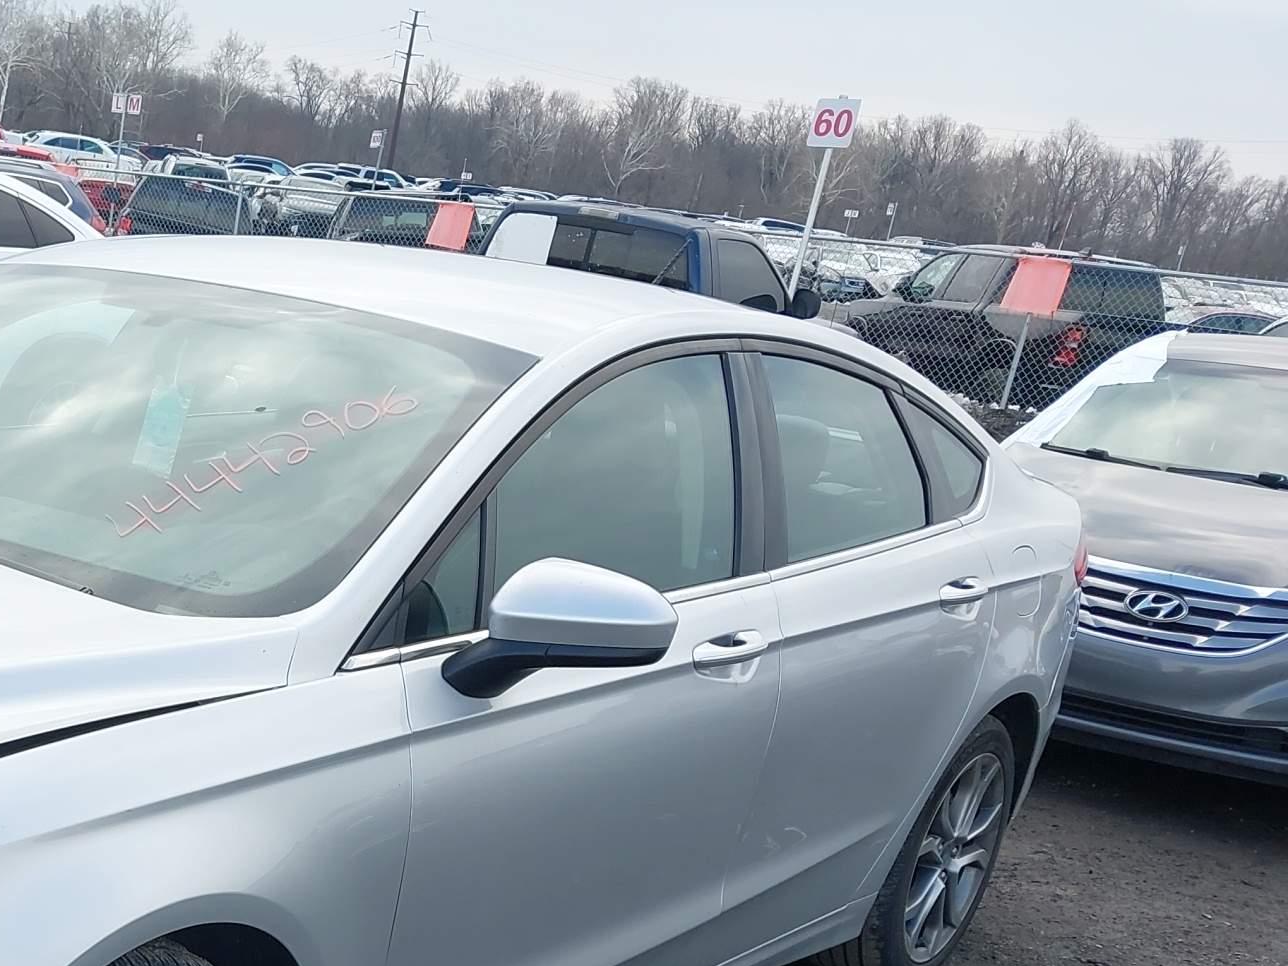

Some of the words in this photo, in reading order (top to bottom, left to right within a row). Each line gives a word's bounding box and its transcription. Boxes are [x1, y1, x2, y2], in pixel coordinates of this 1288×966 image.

[129, 98, 140, 112] M
[814, 108, 853, 138] 60
[105, 385, 418, 537] 44442906
